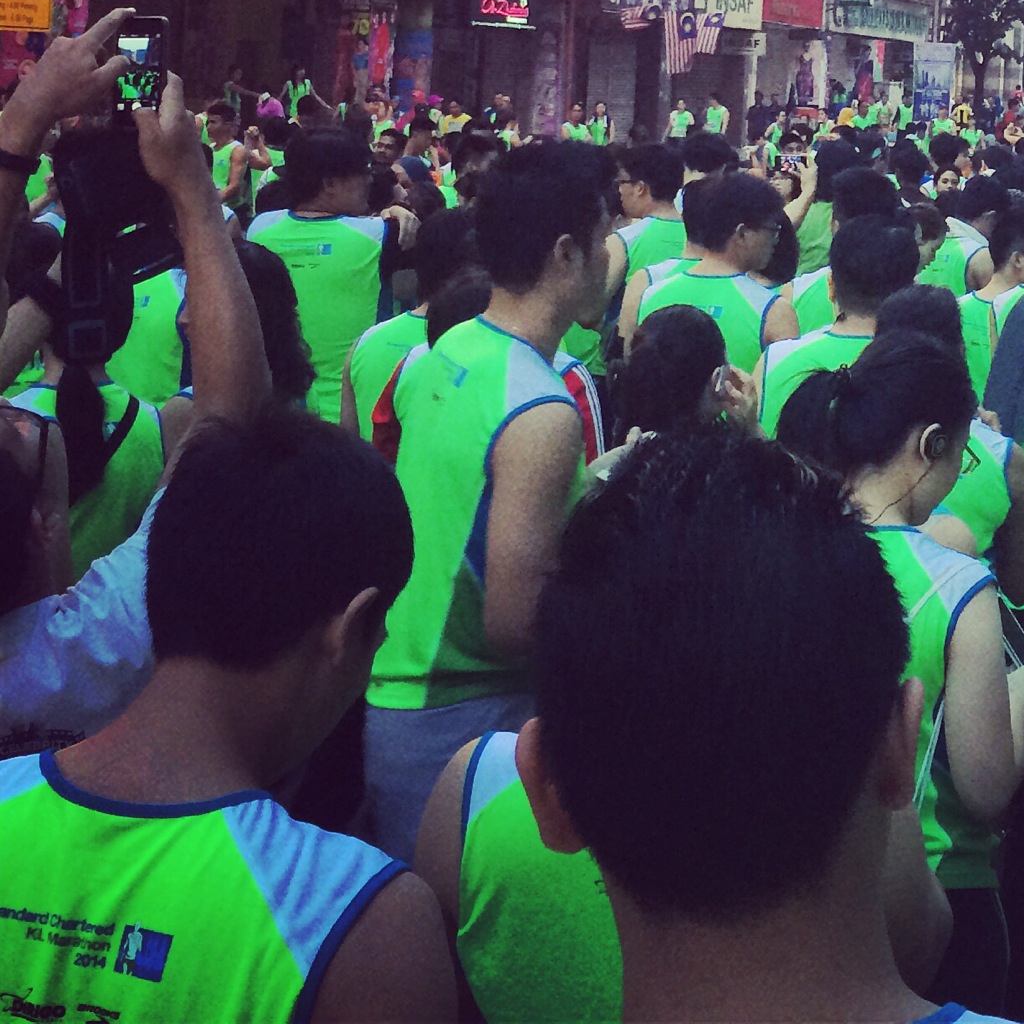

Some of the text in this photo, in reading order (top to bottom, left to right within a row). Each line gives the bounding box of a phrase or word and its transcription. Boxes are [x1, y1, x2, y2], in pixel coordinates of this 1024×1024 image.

[50, 914, 115, 936] Chartered
[26, 927, 111, 952] KL Marathon
[73, 952, 107, 969] 2014
